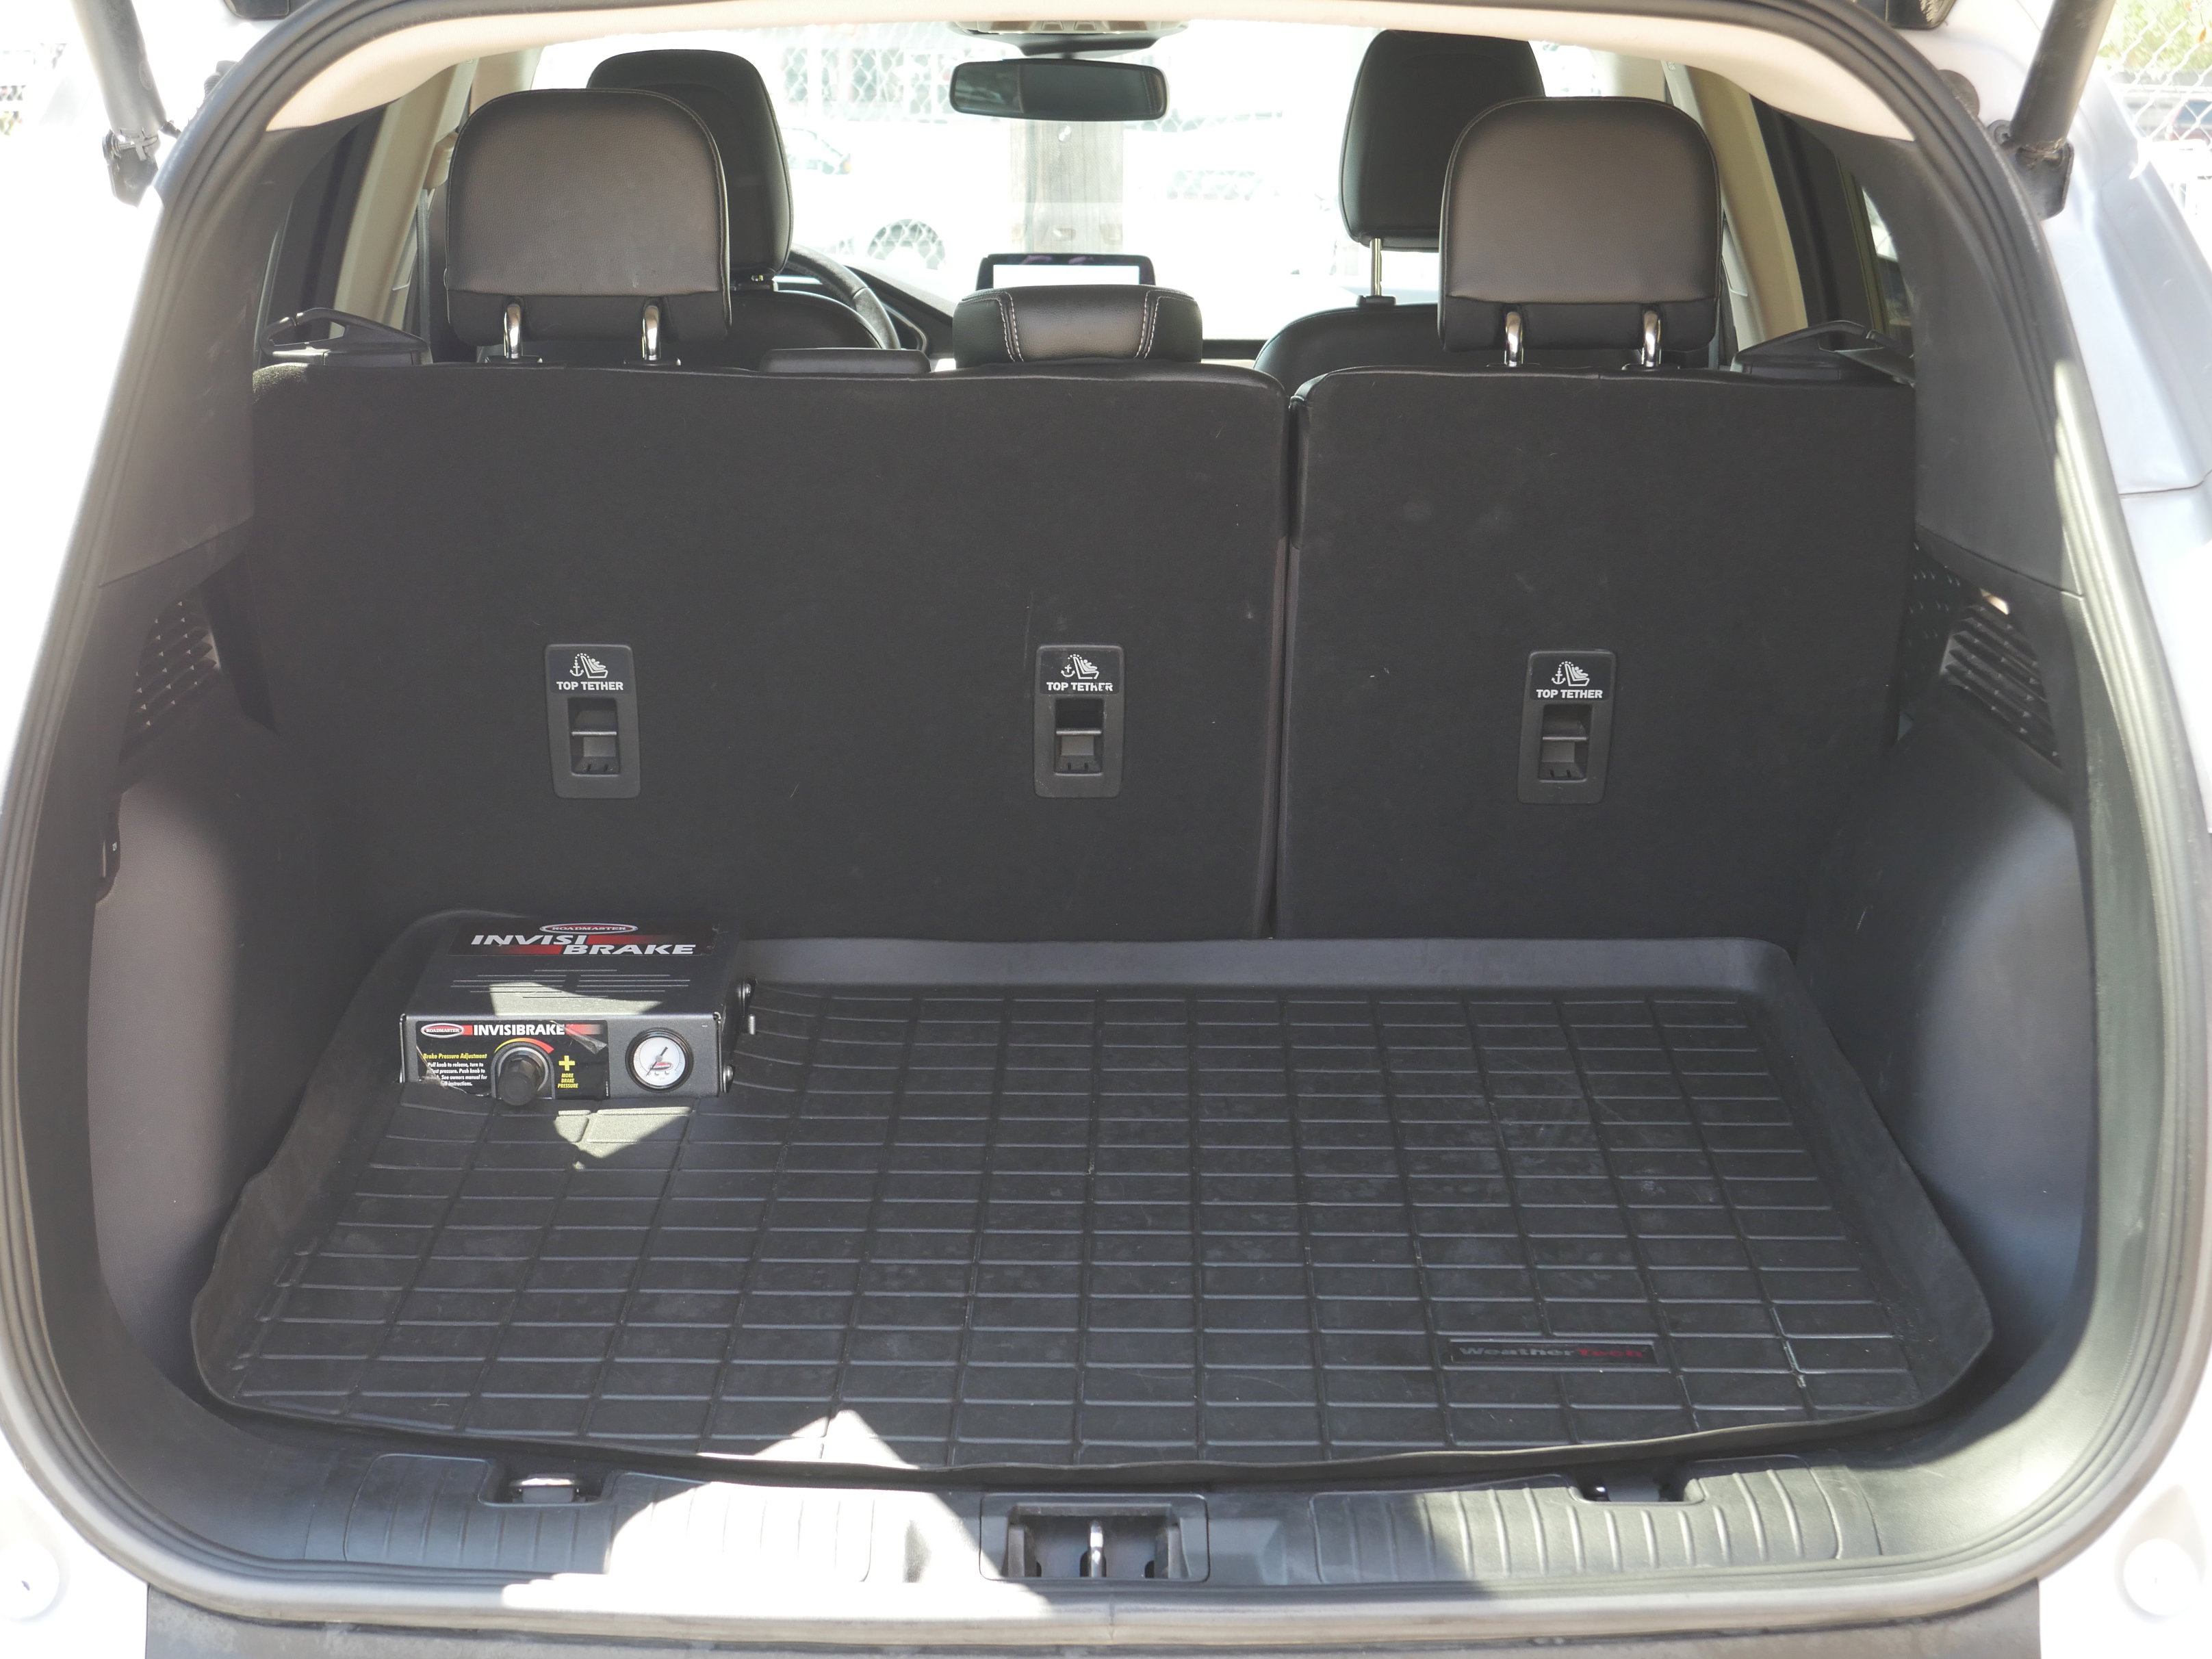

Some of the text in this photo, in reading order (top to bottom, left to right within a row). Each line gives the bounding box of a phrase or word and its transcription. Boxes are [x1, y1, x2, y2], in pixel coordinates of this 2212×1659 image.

[556, 681, 624, 691] TOP TETHER
[1046, 682, 1114, 692] TOP TETHER
[1536, 689, 1604, 699] TOP TETHER
[471, 935, 587, 945] INVISI
[563, 944, 696, 955] BRAKE
[474, 1024, 565, 1036] INVISIBRAKE
